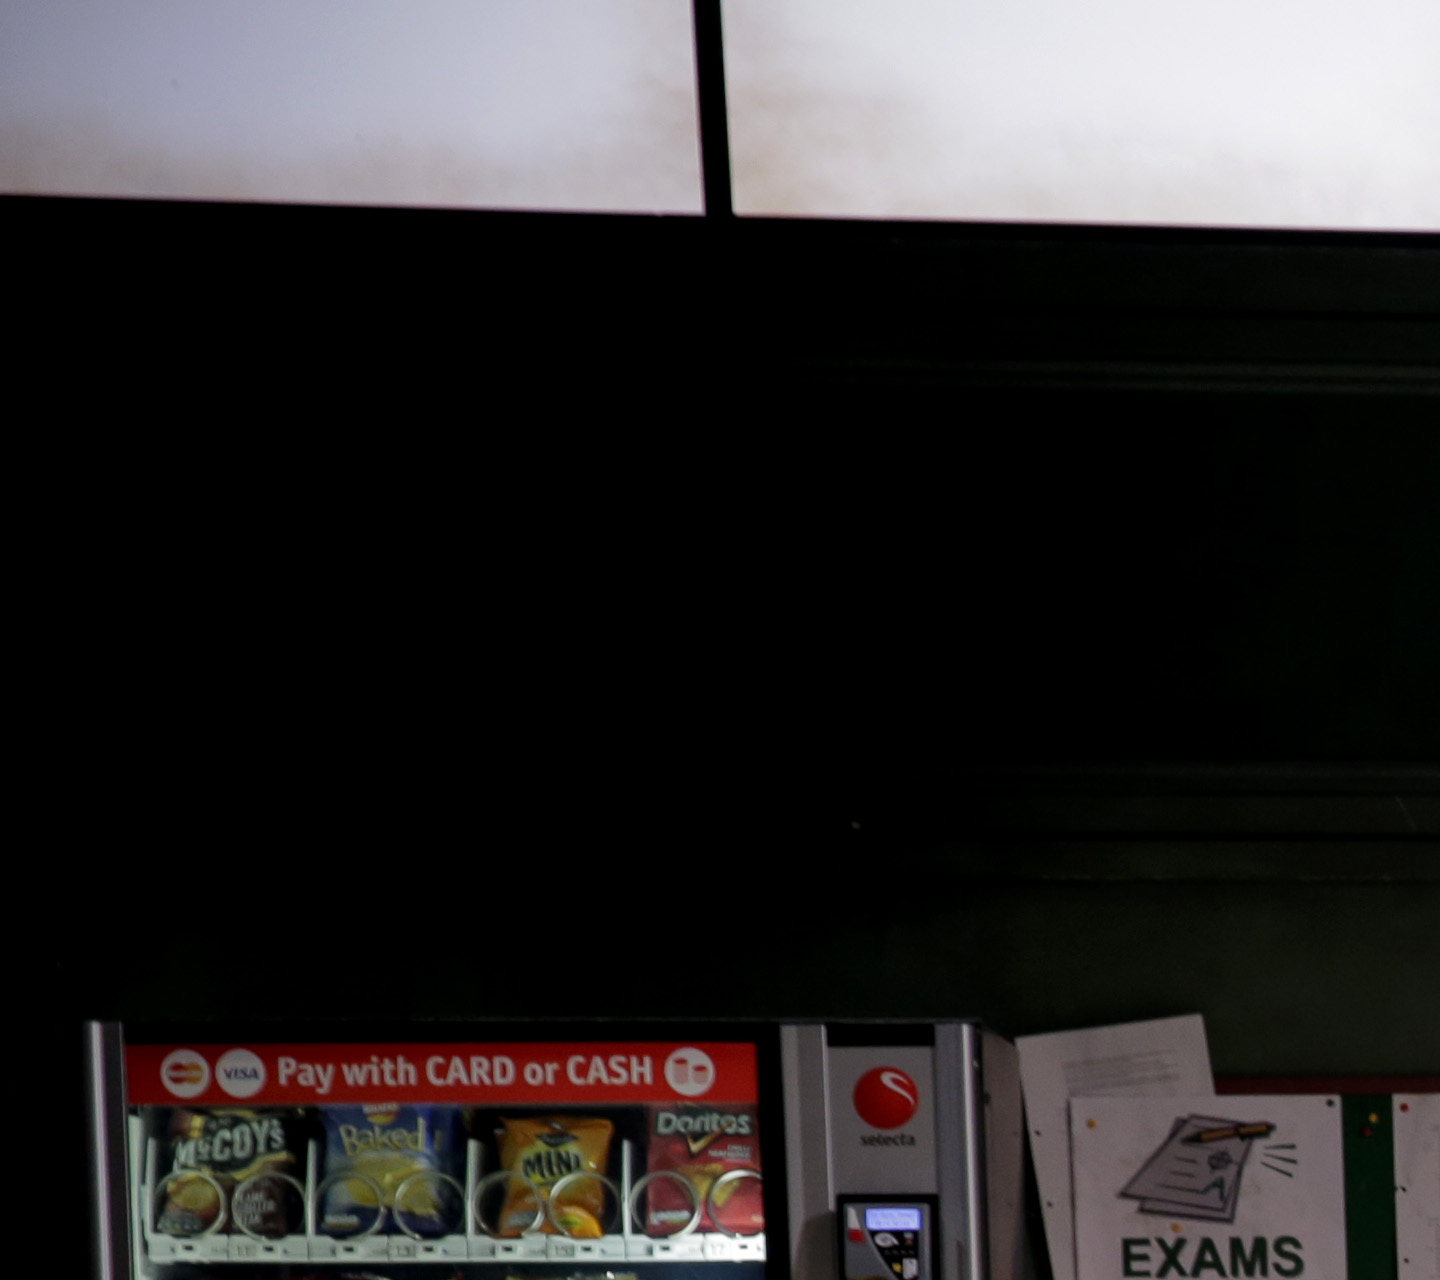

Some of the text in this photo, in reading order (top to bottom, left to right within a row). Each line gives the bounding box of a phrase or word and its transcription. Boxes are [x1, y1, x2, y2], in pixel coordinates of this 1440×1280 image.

[223, 1067, 260, 1081] VISA
[277, 1054, 654, 1095] Pay with CARD or CASH
[656, 1111, 754, 1136] Doritos
[860, 1133, 916, 1147] selecta
[1122, 1236, 1304, 1278] EXAMS
